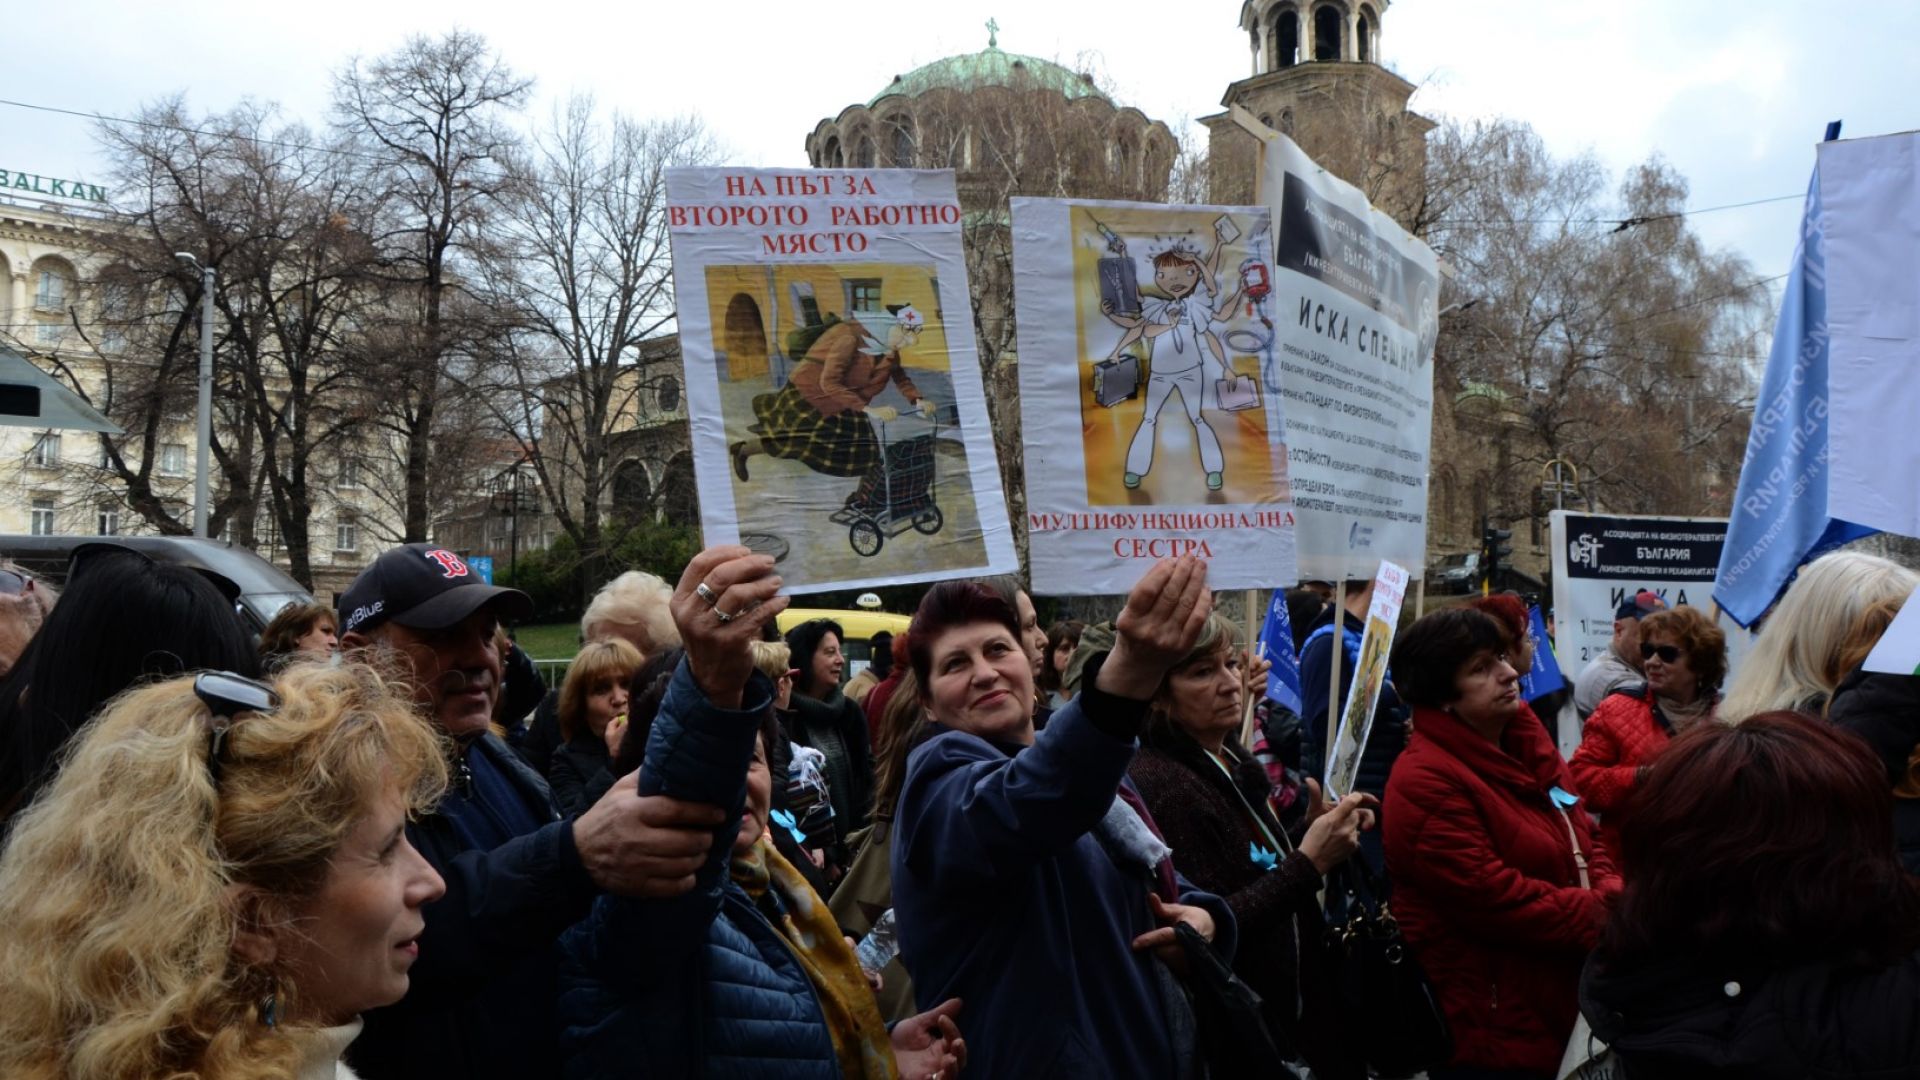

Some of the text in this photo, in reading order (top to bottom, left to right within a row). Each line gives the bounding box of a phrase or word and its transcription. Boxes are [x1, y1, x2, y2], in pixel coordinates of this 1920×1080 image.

[0, 168, 107, 202] BALKAN
[725, 175, 876, 196] НА ПЪТ ЗА
[669, 204, 961, 227] ВТОРОТО РАБОТНО
[762, 231, 868, 255] МЯСТО
[1299, 295, 1349, 346] ИСКА
[1029, 511, 1296, 532] МУЛТИФУНКЦИОНАЛНА
[1113, 537, 1214, 559] СЕСТРА
[1636, 547, 1691, 561] БЪЛГАРИЯ
[424, 549, 468, 579] B
[1580, 619, 1587, 633] 1
[1581, 647, 1588, 661] 2
